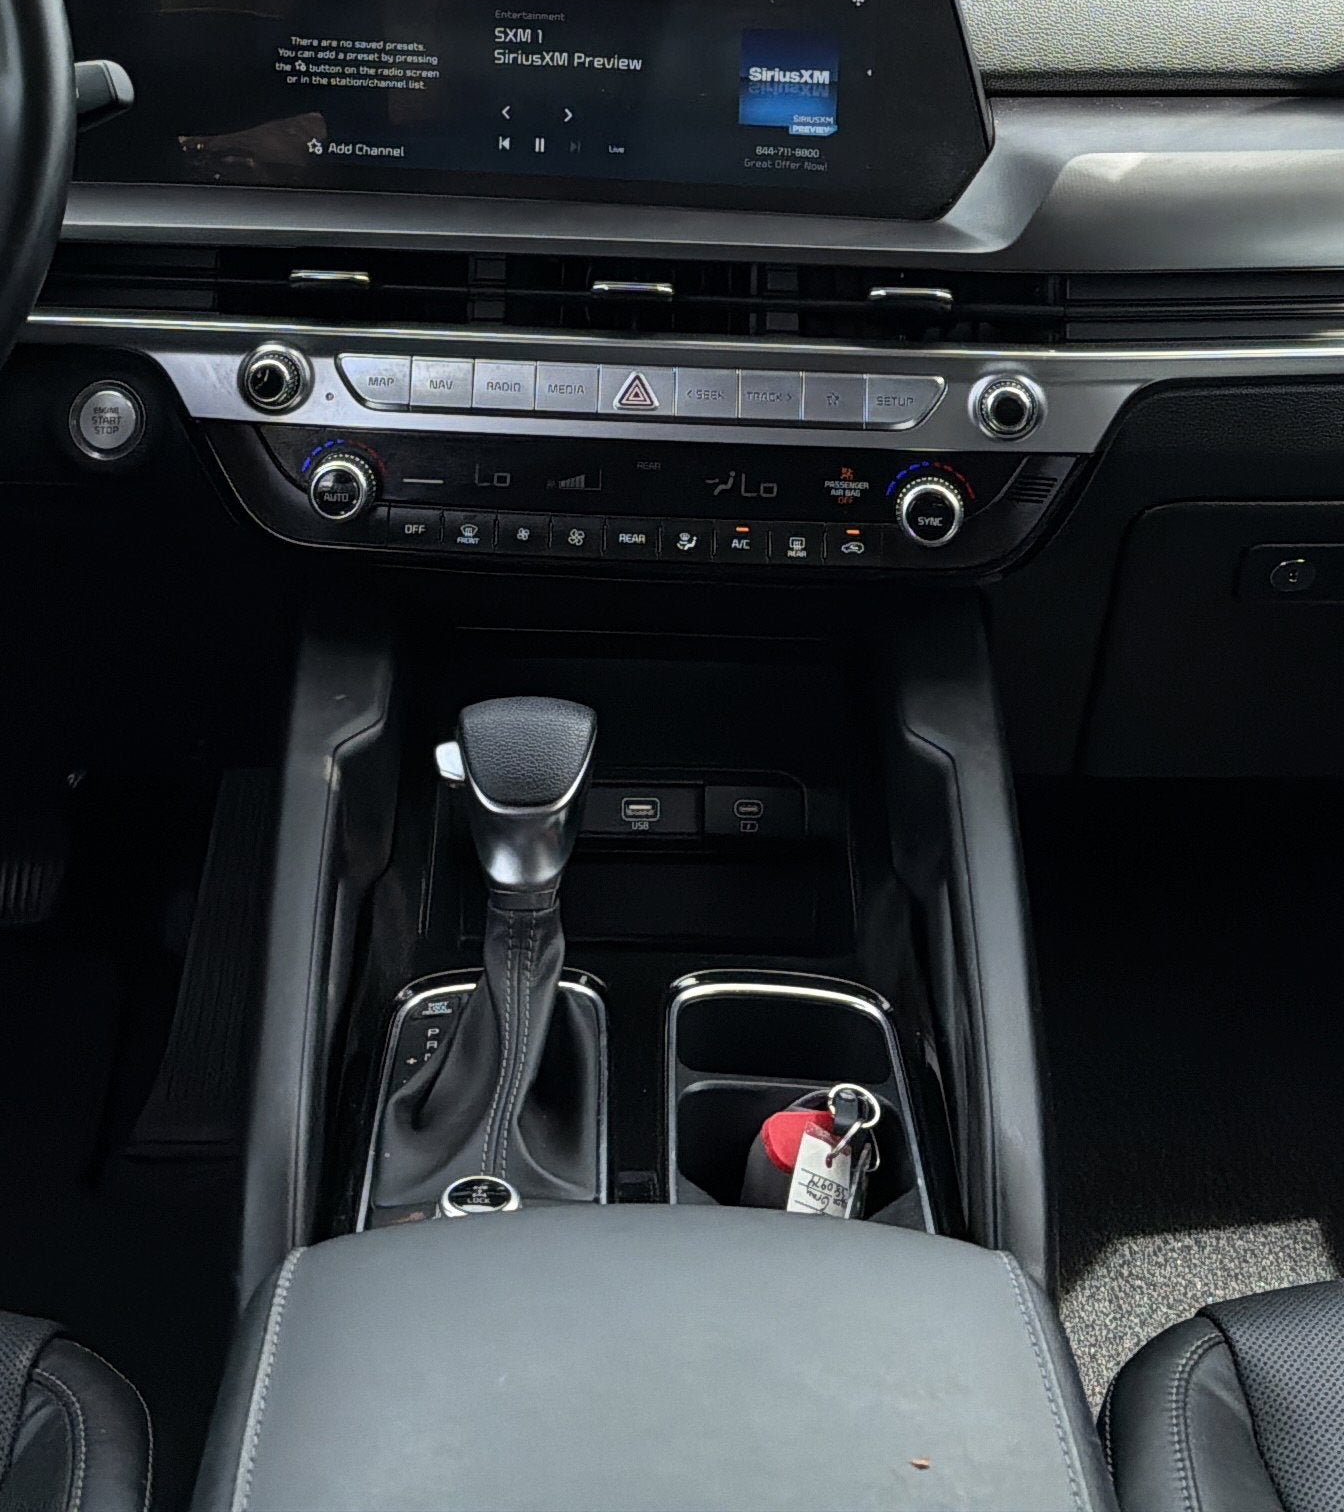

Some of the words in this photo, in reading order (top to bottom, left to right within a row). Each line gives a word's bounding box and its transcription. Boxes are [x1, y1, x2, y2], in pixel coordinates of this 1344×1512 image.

[494, 9, 566, 22] Entertainment
[494, 27, 531, 43] SXM
[537, 29, 544, 44] 1
[290, 36, 318, 47] There
[340, 40, 353, 48] no
[355, 40, 384, 49] saved
[278, 48, 295, 57] You
[317, 51, 336, 60] add
[347, 52, 379, 62] preset
[381, 53, 394, 63] by
[396, 54, 438, 65] pressing
[494, 49, 568, 67] SiriusXM
[574, 53, 642, 71] Preview
[275, 62, 291, 71] the
[309, 64, 342, 74] button
[344, 66, 357, 74] on
[360, 66, 376, 76] the
[378, 67, 403, 77] radio
[406, 69, 439, 78] screen
[748, 66, 830, 85] SiriusXM
[287, 76, 298, 84] or
[301, 75, 309, 84] in
[312, 76, 328, 86] the
[331, 77, 406, 89] station/channel
[792, 114, 834, 125] SIRIUSXM
[328, 143, 352, 155] Add
[355, 144, 405, 157] Channel
[608, 144, 625, 154] Live
[755, 146, 820, 158] 844-711-8800
[744, 158, 773, 169] Great
[774, 160, 802, 170] Offer
[804, 161, 828, 172] Now!
[368, 376, 395, 388] MAP
[429, 378, 454, 390] NAV
[486, 382, 522, 393] RADIO
[547, 384, 586, 395] MEDIA
[876, 396, 914, 407] SETUP
[91, 415, 122, 425] START
[94, 425, 120, 435] STOP
[636, 461, 662, 471] REAR
[824, 480, 870, 490] PASSENGER
[323, 492, 349, 503] AUTO
[845, 489, 861, 497] BAG
[837, 496, 854, 504] OFF
[917, 517, 943, 527] SYNC
[404, 524, 426, 535] OFF
[456, 536, 480, 546] FRONT
[618, 533, 646, 545] REAR
[732, 538, 750, 550] A/C
[787, 550, 807, 559] REAR
[632, 821, 649, 830] USB
[428, 1028, 440, 1038] P
